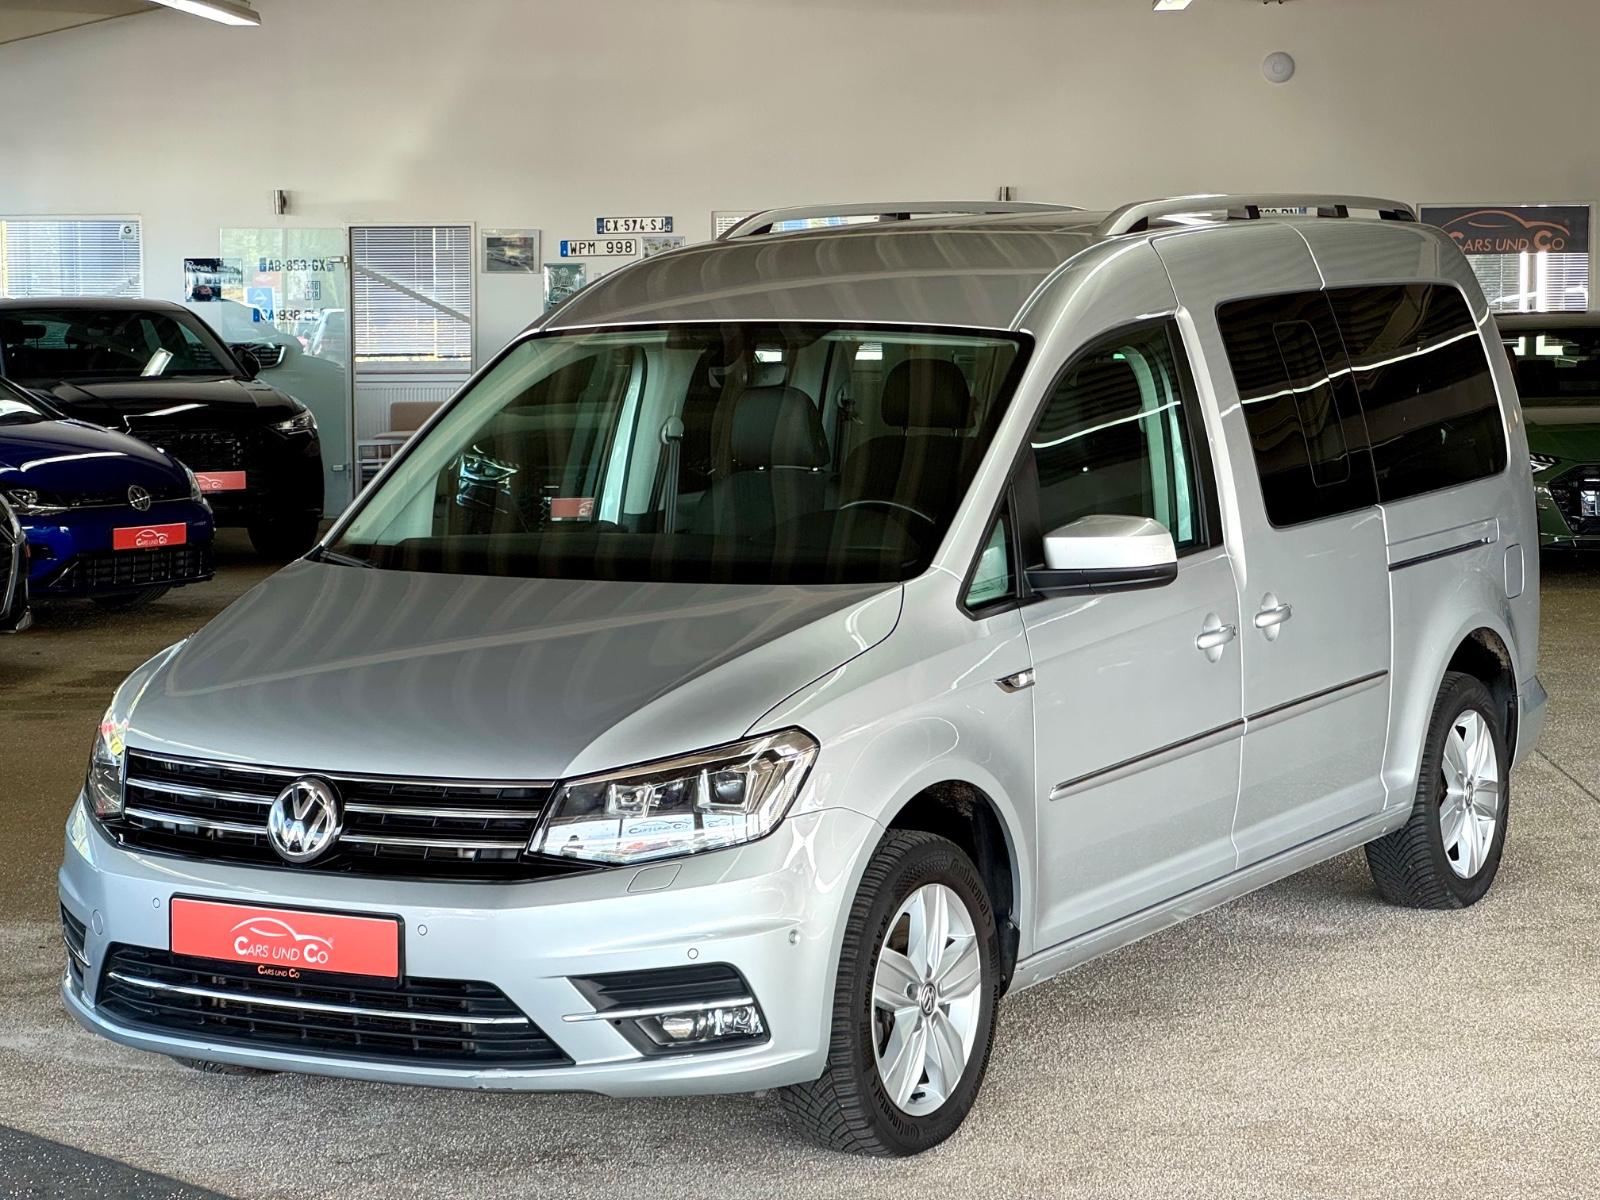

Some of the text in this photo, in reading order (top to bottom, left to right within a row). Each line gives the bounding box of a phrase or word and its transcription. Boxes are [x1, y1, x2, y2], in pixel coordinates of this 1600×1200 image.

[605, 219, 664, 231] CX-574-SJ
[570, 242, 596, 254] WPM
[606, 241, 633, 254] 998
[1495, 238, 1529, 251] UND
[268, 260, 325, 271] AB-853-GX
[234, 936, 268, 957] CARS
[272, 948, 300, 961] UND
[275, 969, 288, 977] UND
